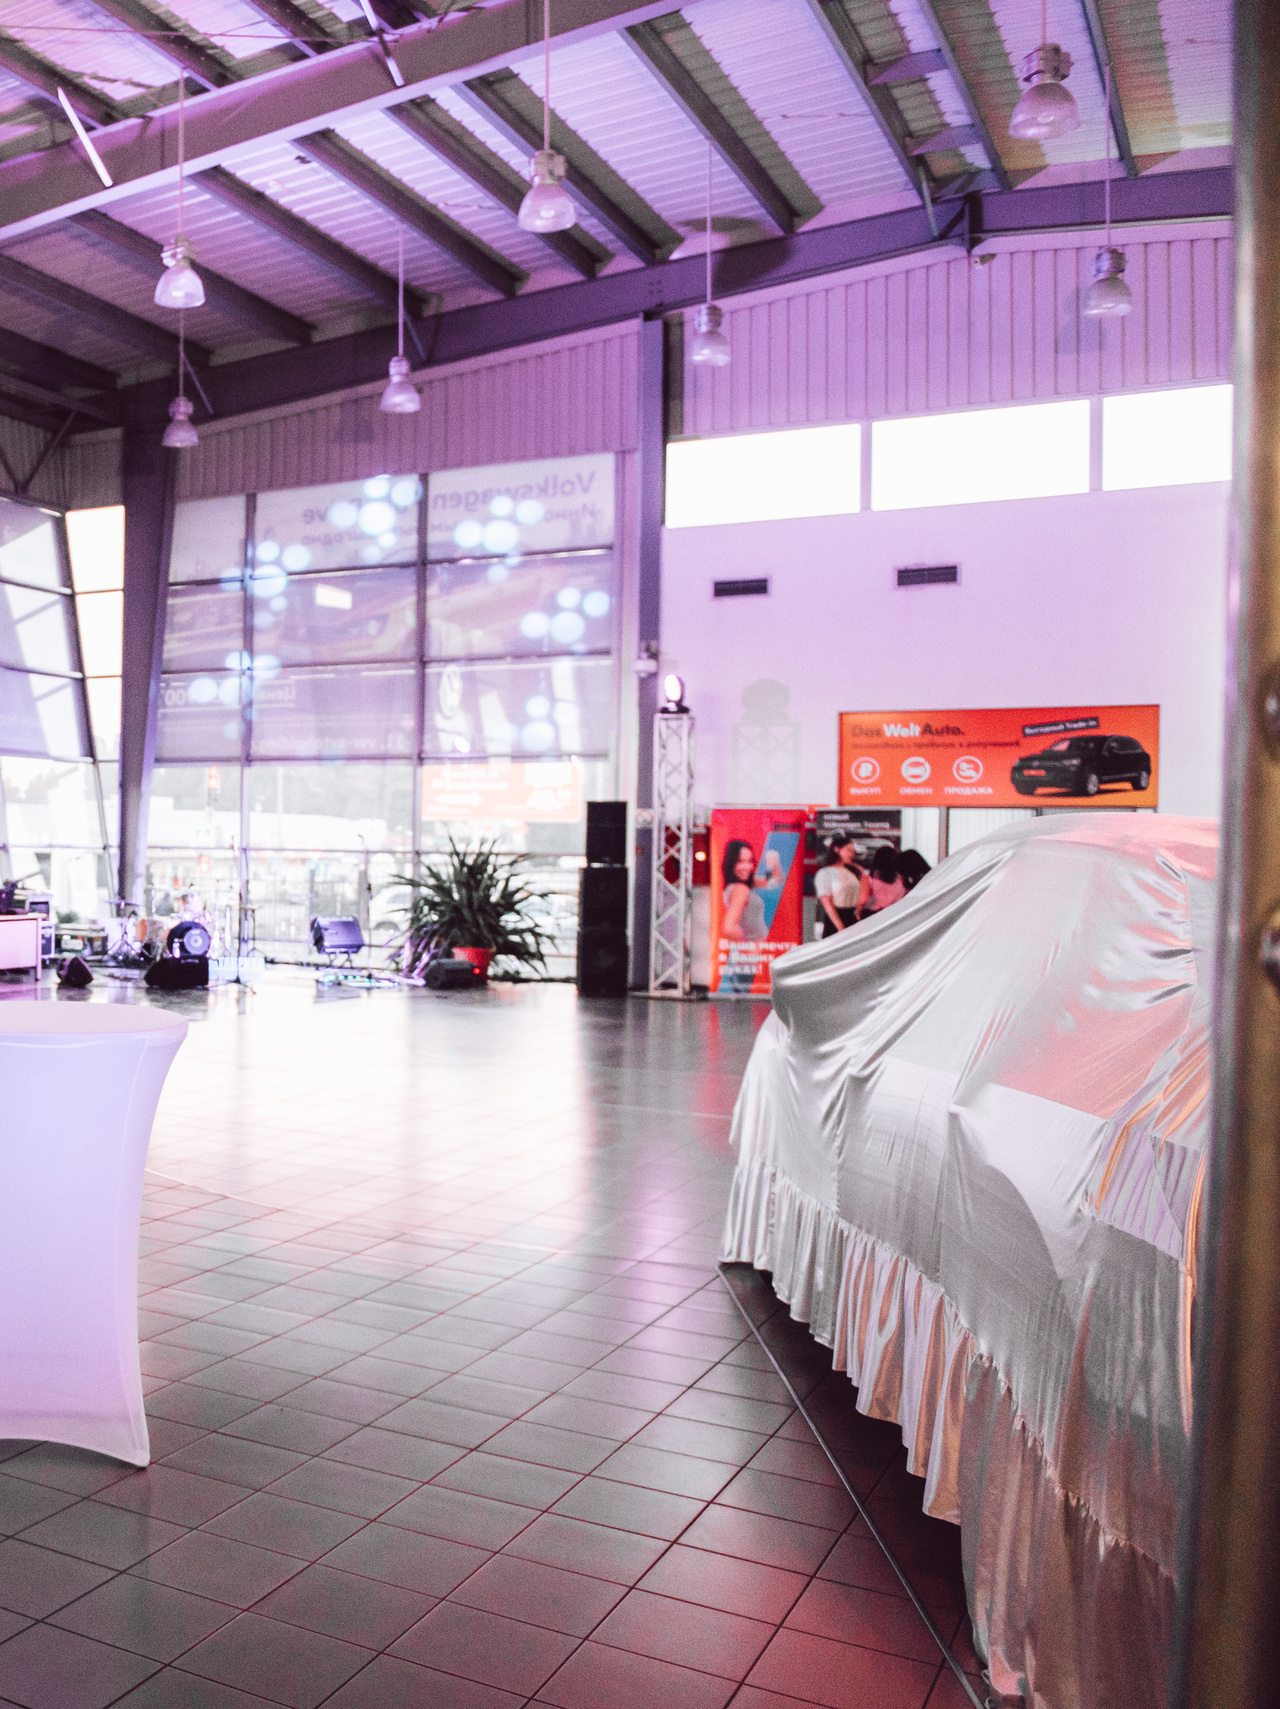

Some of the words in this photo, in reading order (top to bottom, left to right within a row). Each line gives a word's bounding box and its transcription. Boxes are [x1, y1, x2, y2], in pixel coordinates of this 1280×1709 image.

[850, 786, 881, 795] ВЫКУП
[898, 786, 933, 795] ОБМЕН
[944, 786, 994, 795] ПРОДАЖА
